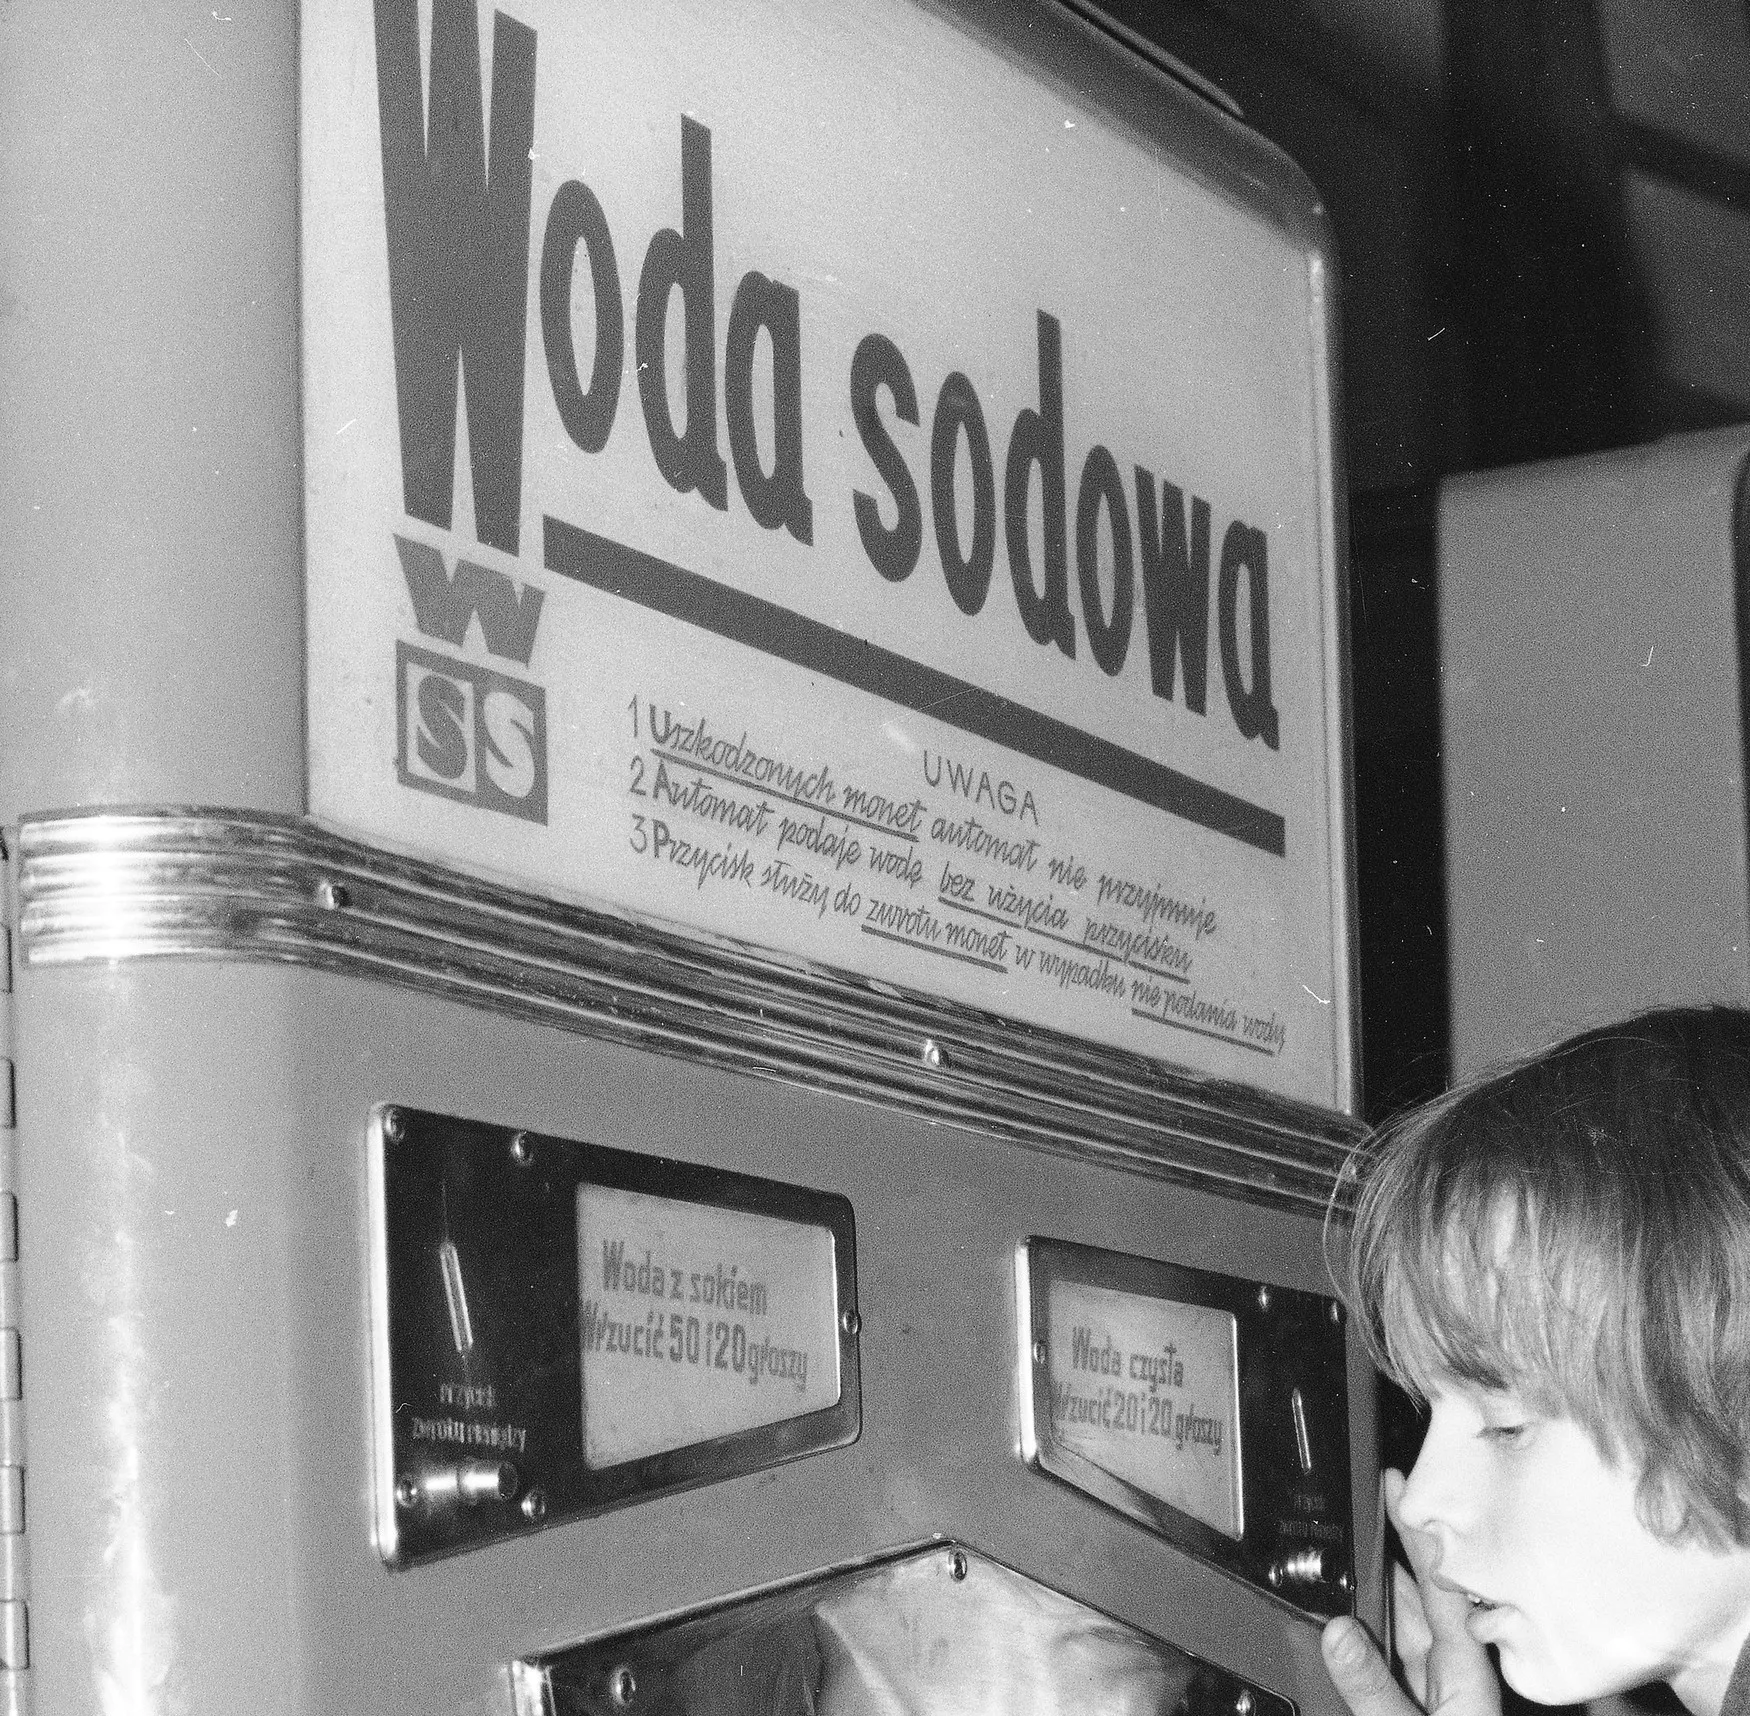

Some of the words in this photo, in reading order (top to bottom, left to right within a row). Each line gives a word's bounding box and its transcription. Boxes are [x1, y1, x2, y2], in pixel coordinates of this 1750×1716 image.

[373, 0, 813, 557] Woda
[849, 308, 1280, 752] sodowa
[628, 693, 639, 738] 1
[650, 703, 837, 803] Uszkodzonych
[843, 785, 928, 834] monet
[931, 816, 1041, 872] automat
[1049, 855, 1088, 890] nie
[923, 749, 1040, 827] UWAGA
[629, 755, 647, 796] 2
[653, 758, 775, 837] Automat
[778, 815, 862, 870] podaje
[870, 846, 923, 888] wodę
[940, 860, 975, 902] bez
[988, 883, 1069, 929] użycia
[630, 813, 648, 854] 3
[652, 818, 755, 890] Przycisk
[761, 859, 829, 919] służy
[834, 882, 861, 916] do
[867, 899, 942, 941] zwrotu
[945, 922, 1013, 961] monet
[1015, 944, 1037, 970] w
[1039, 950, 1127, 998] wypadku
[1131, 976, 1162, 1008] nie
[1163, 989, 1239, 1031] podania
[1243, 1012, 1286, 1055] wody
[603, 1239, 665, 1298] Woda
[669, 1268, 685, 1300] z
[690, 1262, 768, 1316] sokiem
[670, 1313, 700, 1365] 50
[715, 1321, 747, 1373] 20
[1072, 1326, 1122, 1377] Woda
[1130, 1343, 1184, 1393] czysta
[1112, 1389, 1139, 1432] 20
[1149, 1396, 1173, 1436] 20
